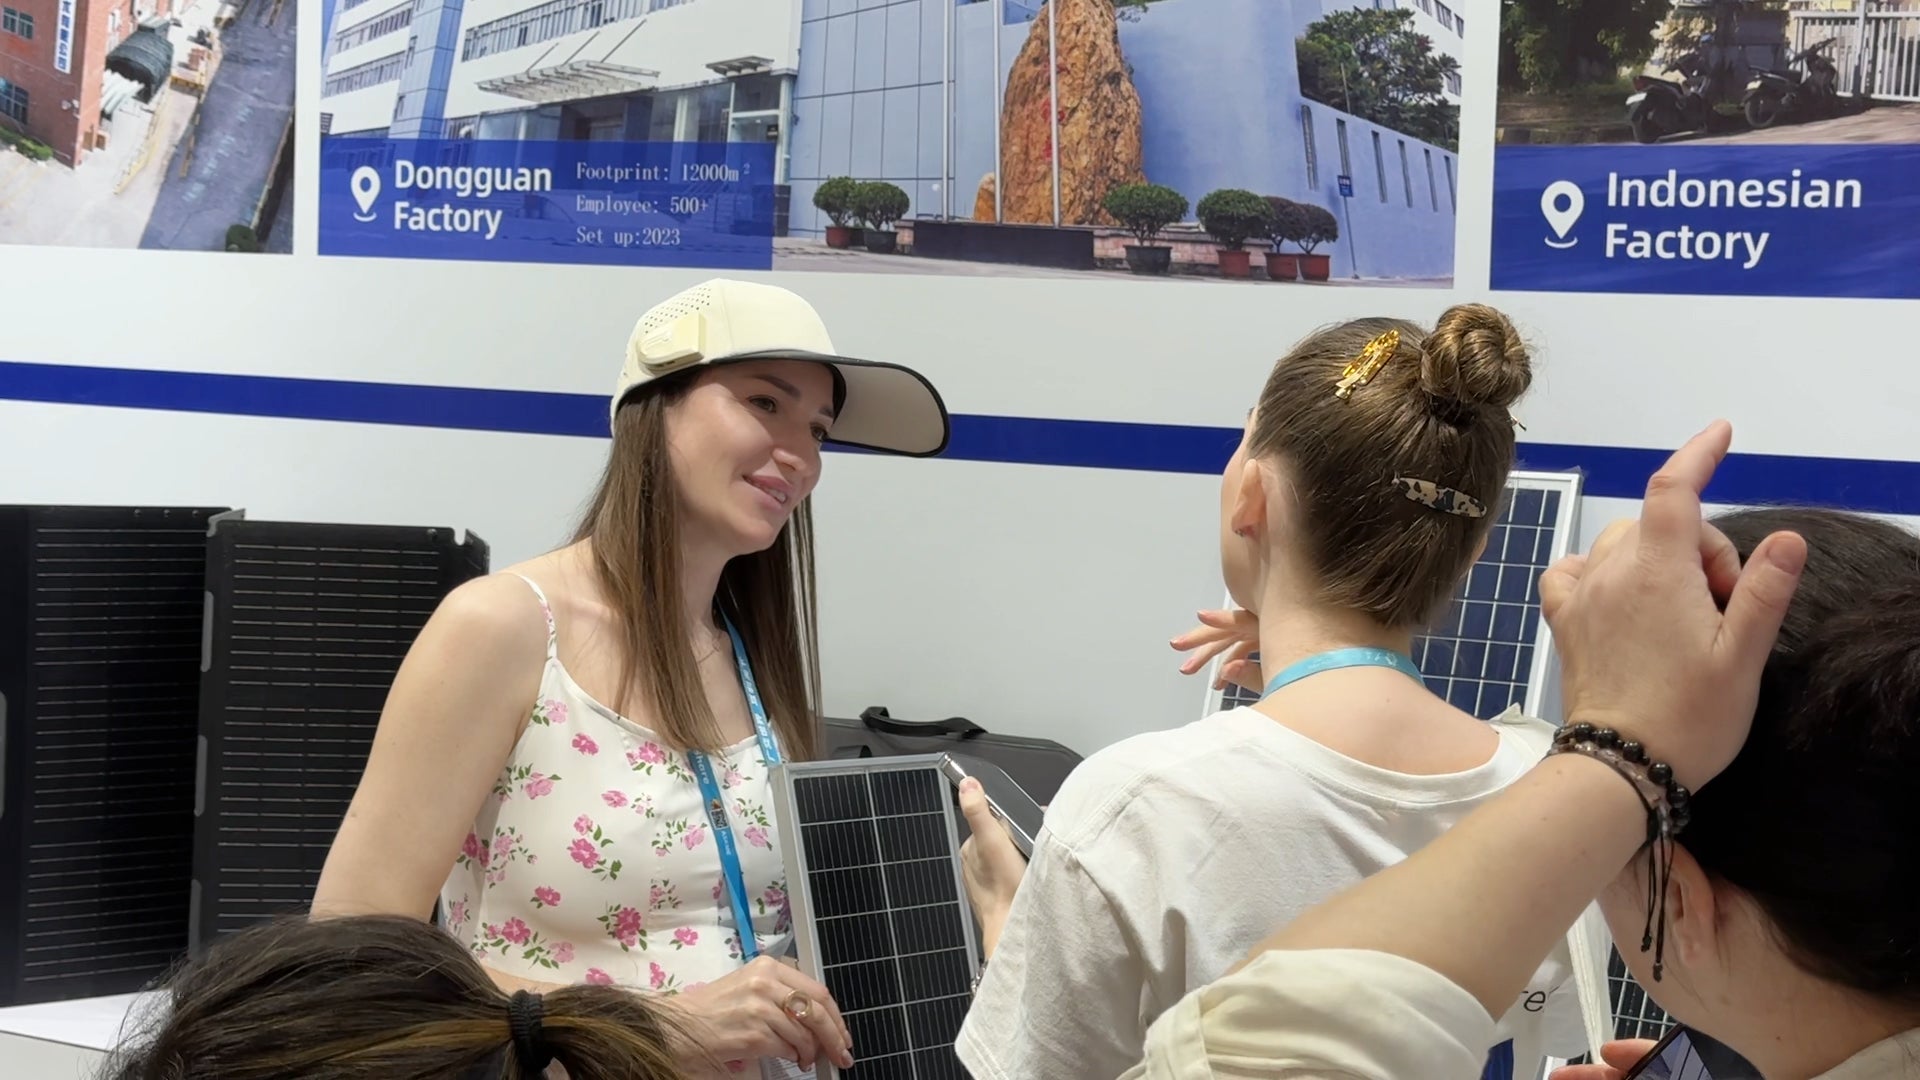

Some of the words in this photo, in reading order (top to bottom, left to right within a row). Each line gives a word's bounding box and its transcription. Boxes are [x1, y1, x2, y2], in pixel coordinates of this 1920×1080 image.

[395, 159, 552, 198] Dongguan
[576, 162, 669, 183] Footprint:
[1607, 169, 1862, 208] Indonesian
[394, 201, 502, 240] Factory
[576, 194, 659, 216] Employee:
[670, 196, 709, 214] 500+
[576, 226, 603, 244] Set
[614, 228, 681, 247] up:2023
[1605, 223, 1770, 269] Factory
